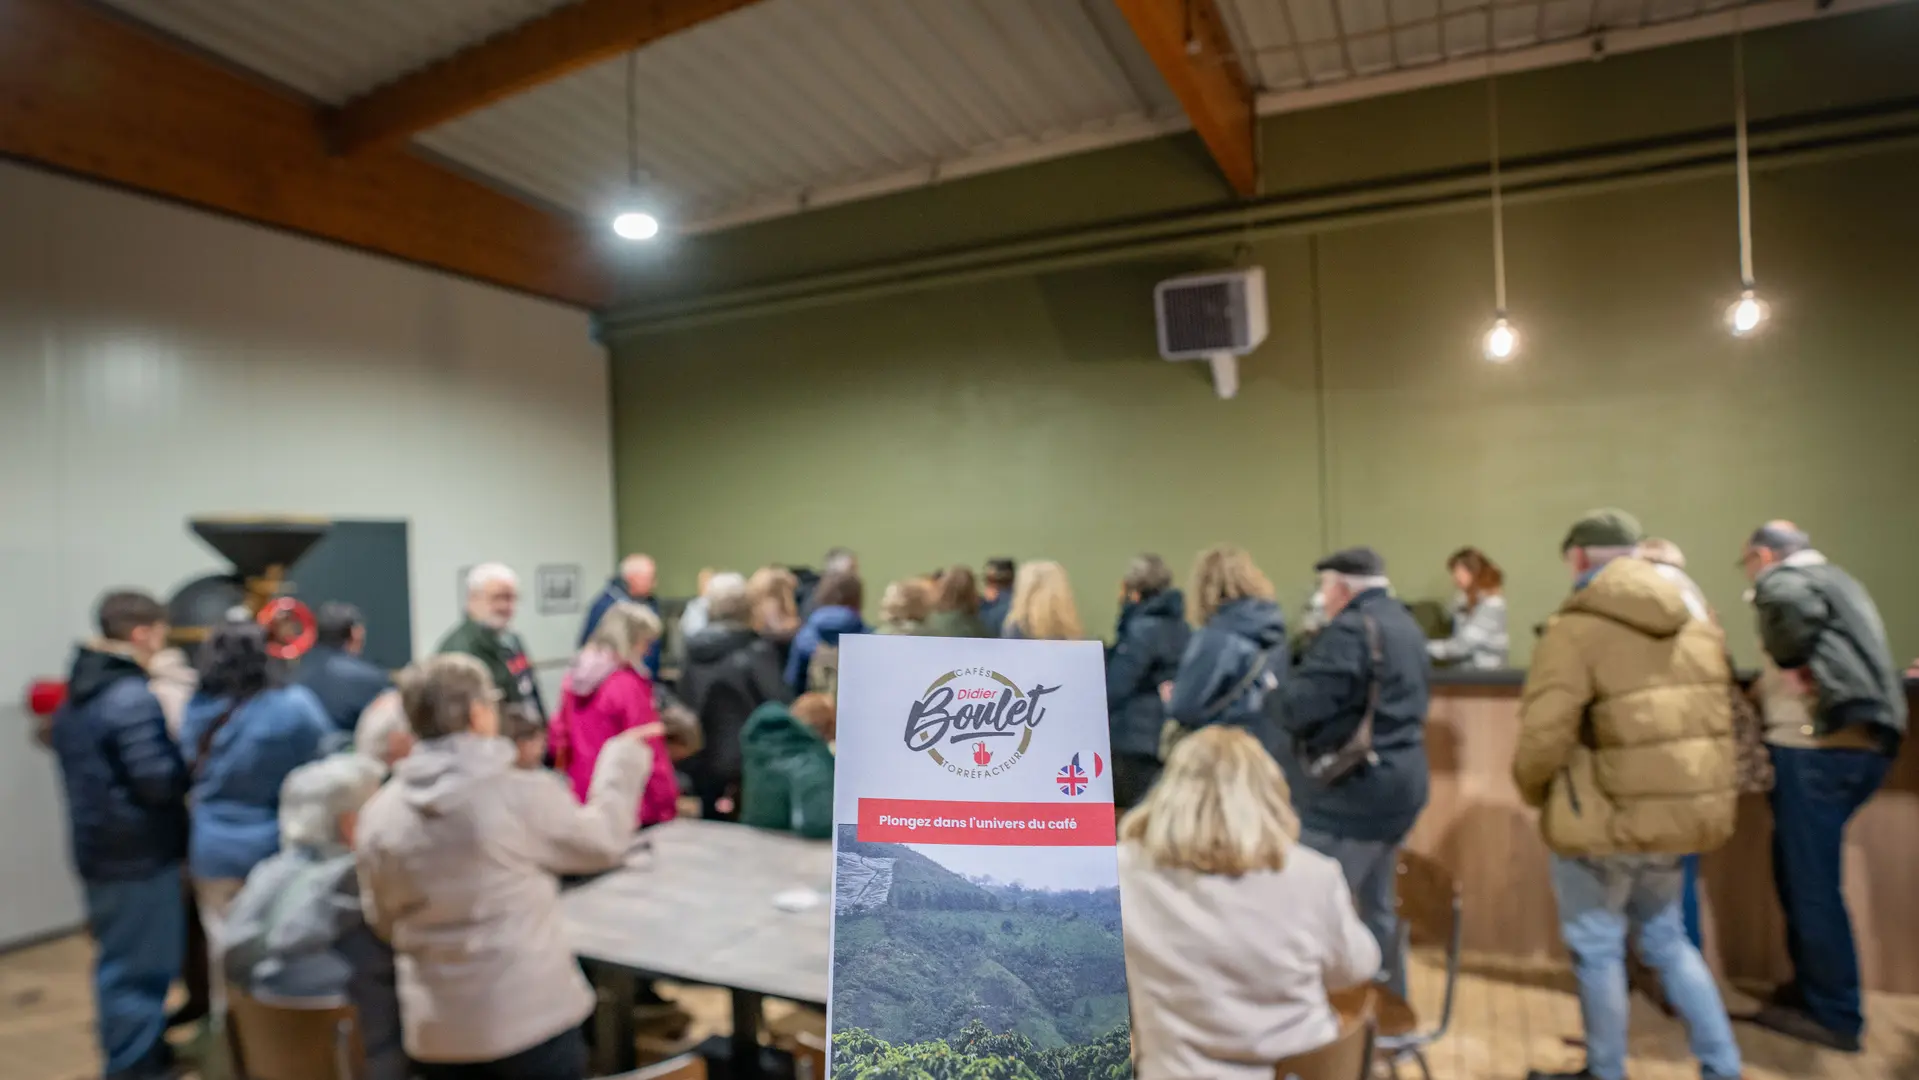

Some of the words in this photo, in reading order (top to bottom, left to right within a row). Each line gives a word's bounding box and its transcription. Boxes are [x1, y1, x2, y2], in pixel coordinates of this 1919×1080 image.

[955, 666, 992, 678] CAFÉS
[957, 688, 997, 700] Didier
[904, 684, 1063, 752] Boulet
[941, 751, 1023, 779] TORRÉFACTEUR
[879, 814, 931, 831] Plongez
[933, 815, 967, 829] dans
[969, 816, 1025, 830] l'univers
[1028, 817, 1046, 830] du
[1048, 817, 1077, 830] café
